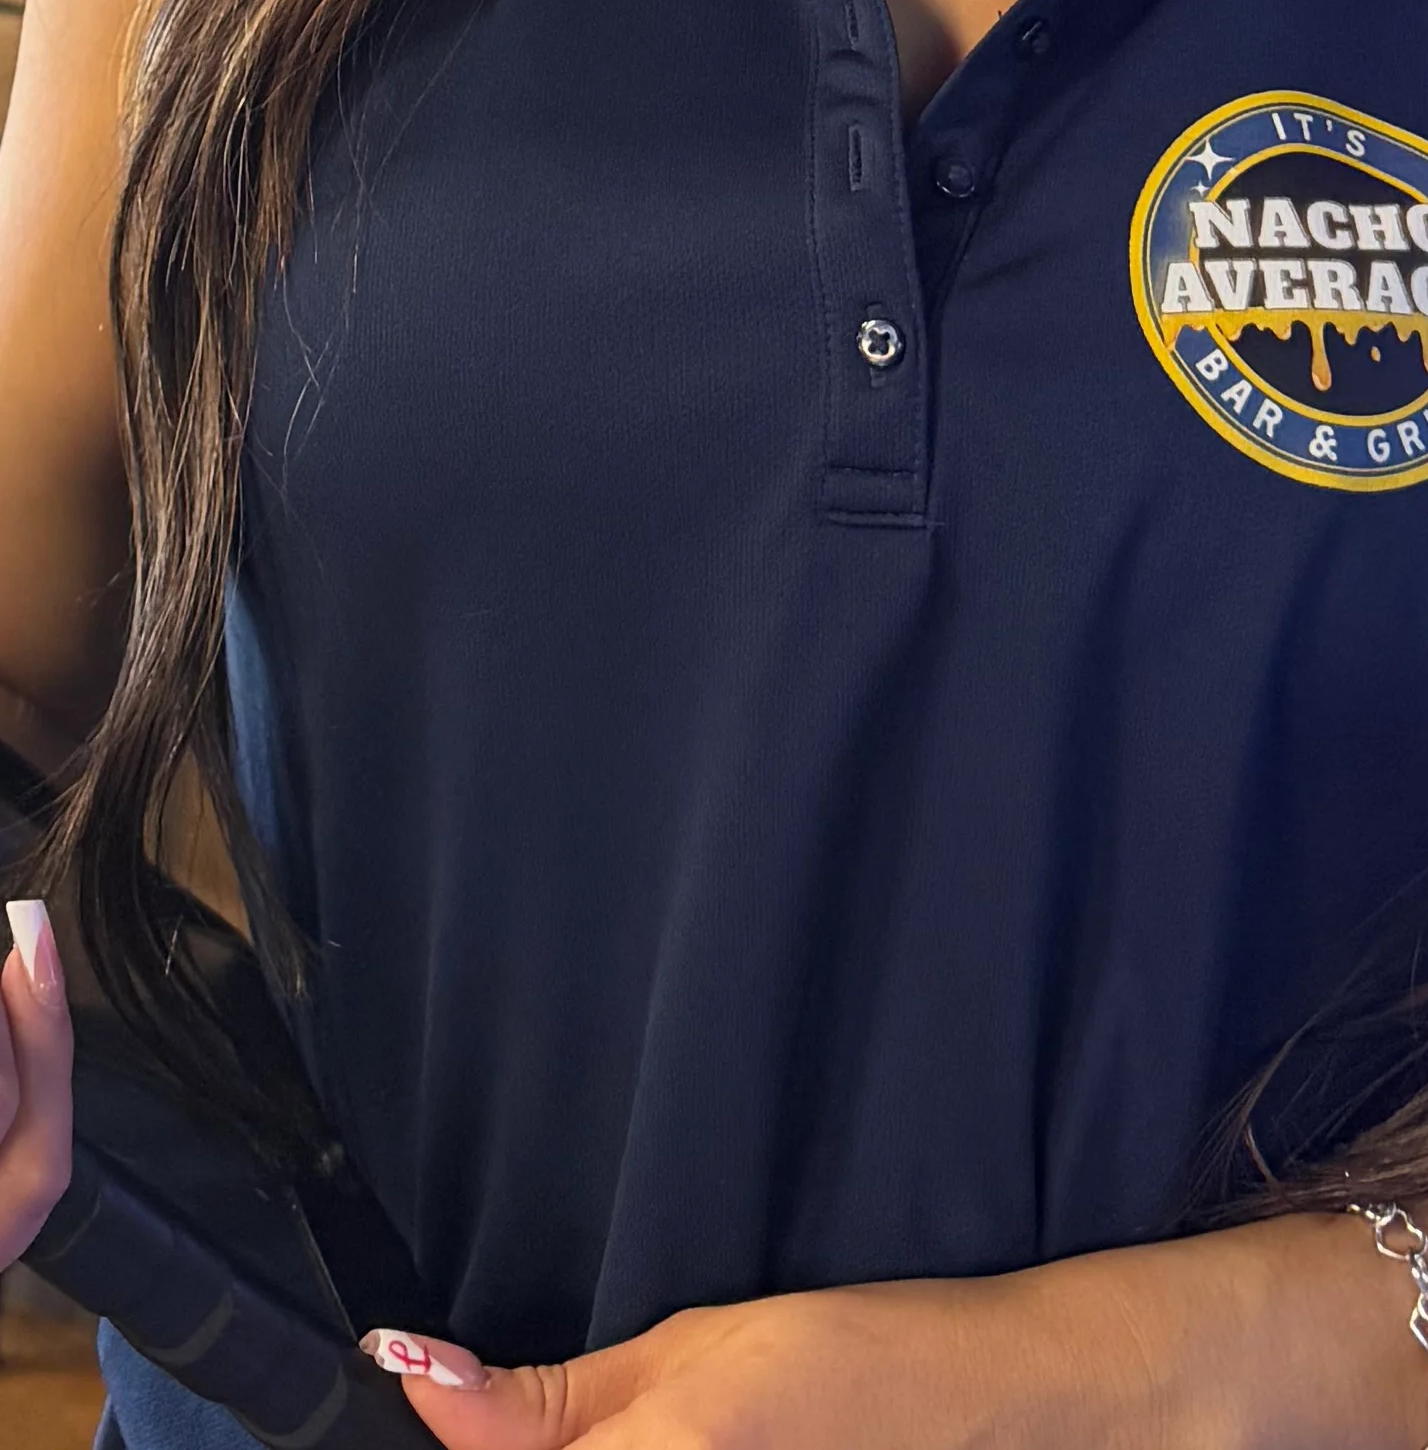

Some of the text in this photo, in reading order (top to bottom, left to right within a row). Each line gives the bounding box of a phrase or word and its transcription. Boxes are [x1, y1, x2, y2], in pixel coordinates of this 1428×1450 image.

[1271, 112, 1367, 158] IT'S
[1194, 348, 1284, 437] BAR
[1308, 424, 1339, 462] &
